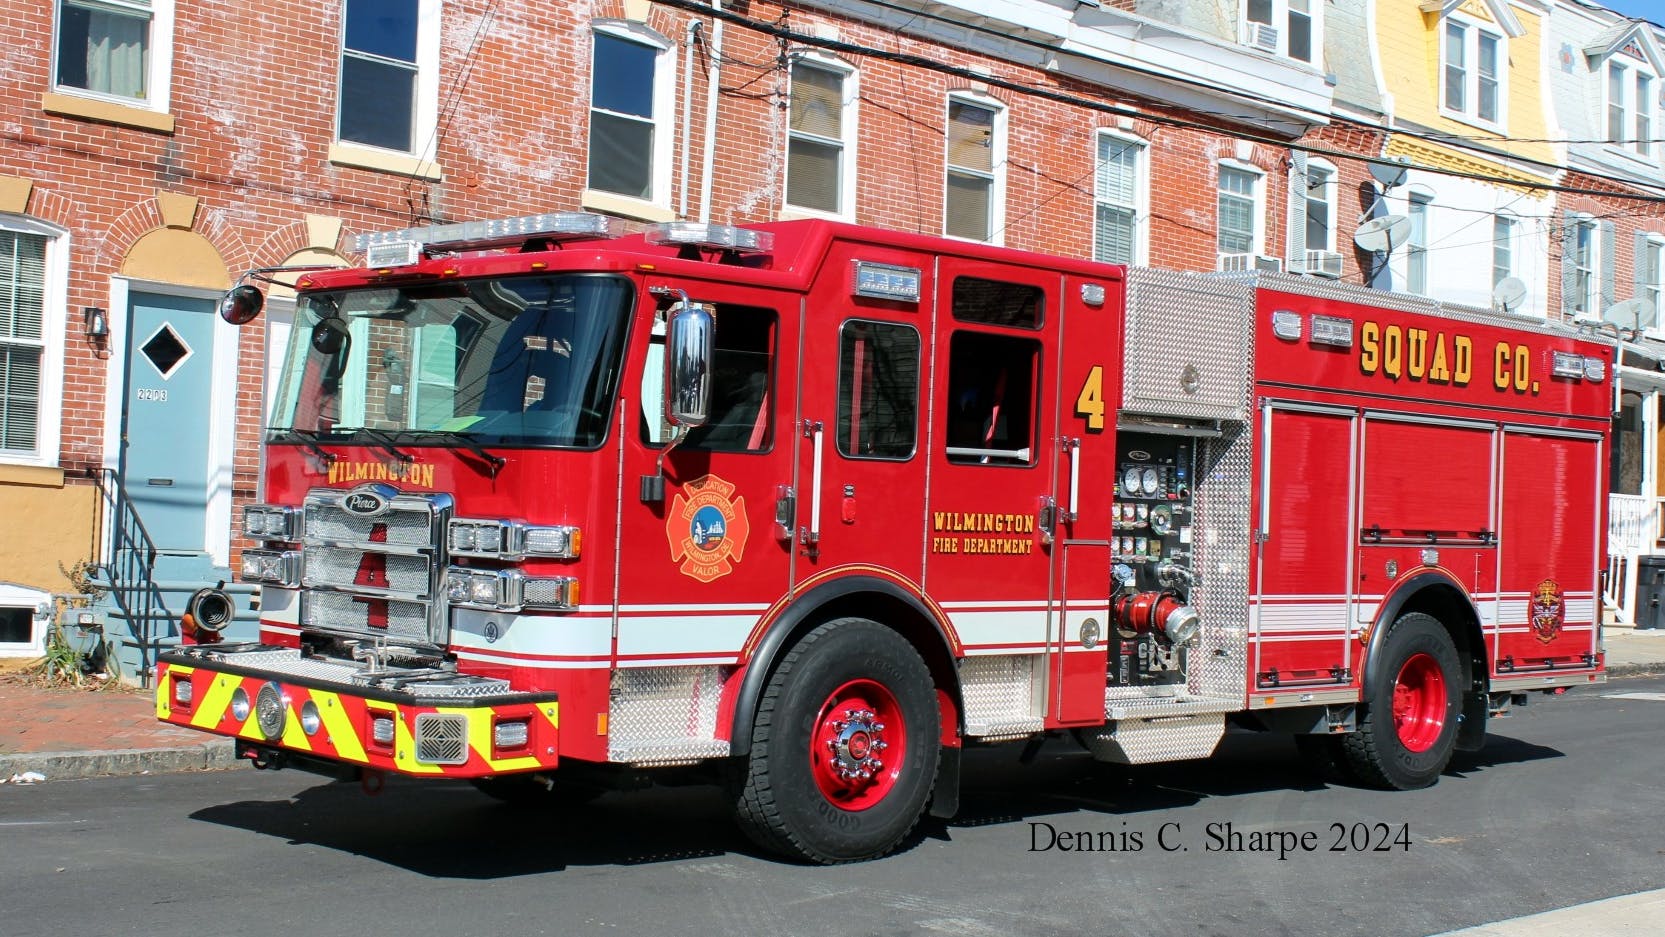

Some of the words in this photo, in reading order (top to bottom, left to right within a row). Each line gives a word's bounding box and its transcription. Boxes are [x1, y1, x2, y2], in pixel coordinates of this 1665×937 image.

[1361, 321, 1473, 384] SQUAD
[1494, 341, 1540, 395] CO.
[1074, 365, 1105, 434] 4
[328, 461, 435, 489] WILMINGTON
[350, 495, 376, 509] Pierce
[934, 512, 1034, 533] WILMINGTON
[933, 537, 959, 554] FIRE
[963, 538, 1033, 555] DEPARTMENT
[692, 564, 720, 576] VALOR
